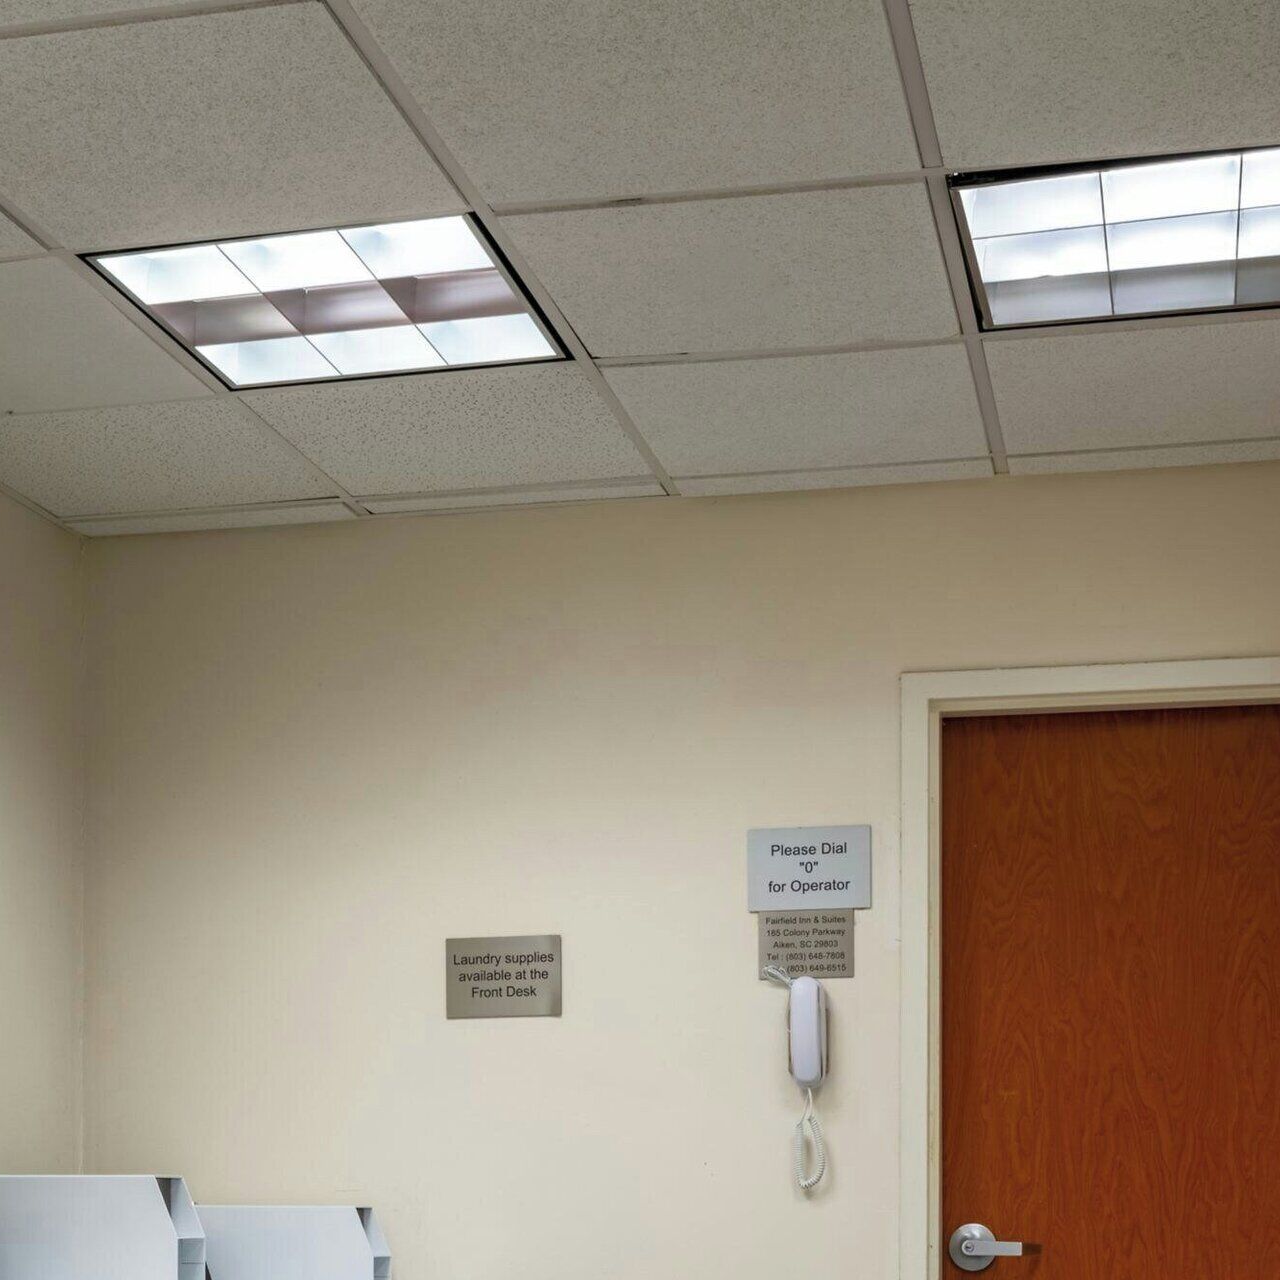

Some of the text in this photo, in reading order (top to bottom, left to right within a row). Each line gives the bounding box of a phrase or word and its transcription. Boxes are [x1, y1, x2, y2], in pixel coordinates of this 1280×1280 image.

[771, 842, 848, 856] Please Dial
[768, 879, 851, 894] for Operator
[765, 915, 846, 925] Fairfield Inn & Suites
[783, 928, 810, 938] Colony
[812, 928, 846, 937] Parkway
[800, 940, 812, 949] SC
[814, 940, 839, 948] 29803
[453, 951, 554, 967] Laundry supplies
[458, 968, 549, 982] available at the
[471, 985, 537, 998] Front Desk
